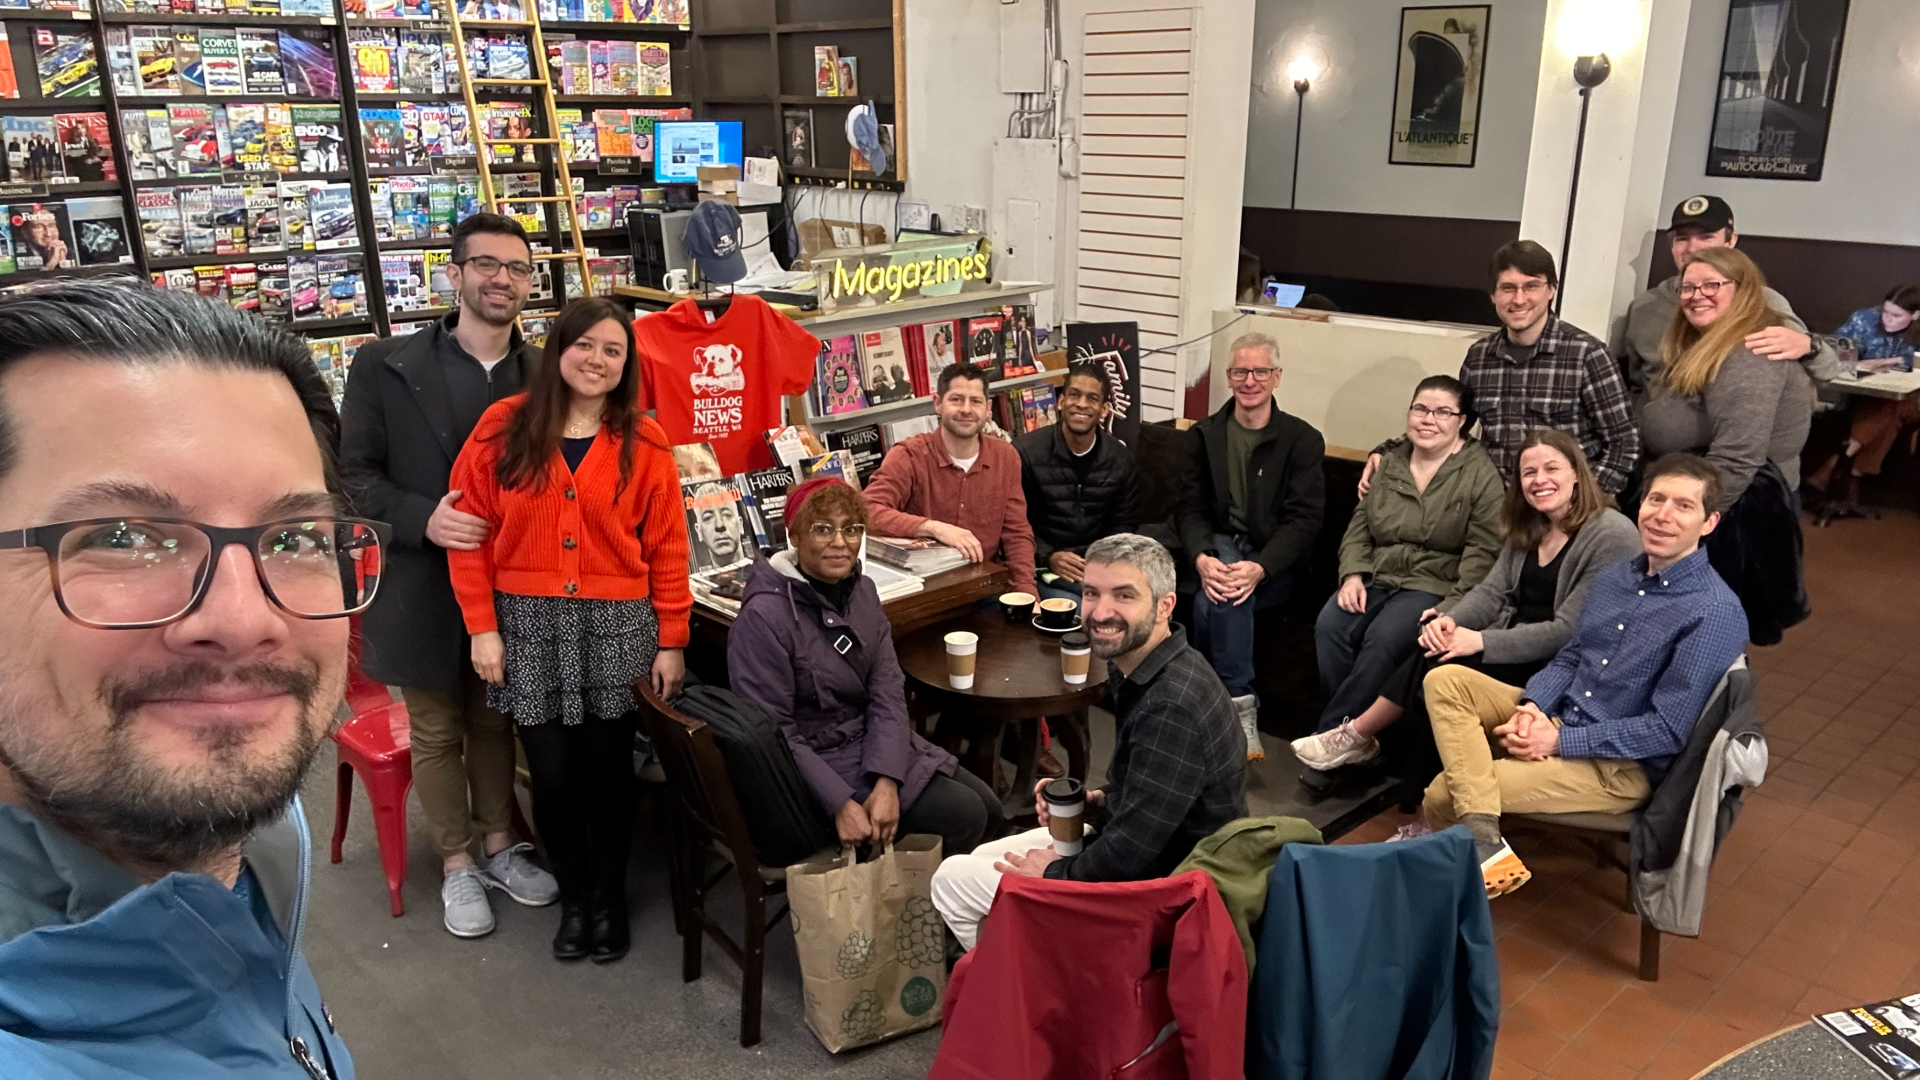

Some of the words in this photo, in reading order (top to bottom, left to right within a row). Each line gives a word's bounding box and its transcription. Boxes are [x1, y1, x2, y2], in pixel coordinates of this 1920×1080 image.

[57, 116, 108, 129] SUCESS
[294, 125, 327, 137] ENZO
[235, 154, 262, 163] USED
[138, 199, 176, 207] CLASSICS
[21, 212, 56, 222] Forbes
[832, 253, 987, 302] Magazines
[1097, 349, 1132, 433] Family
[693, 396, 743, 410] BULLDOG
[693, 407, 743, 427] NEWS
